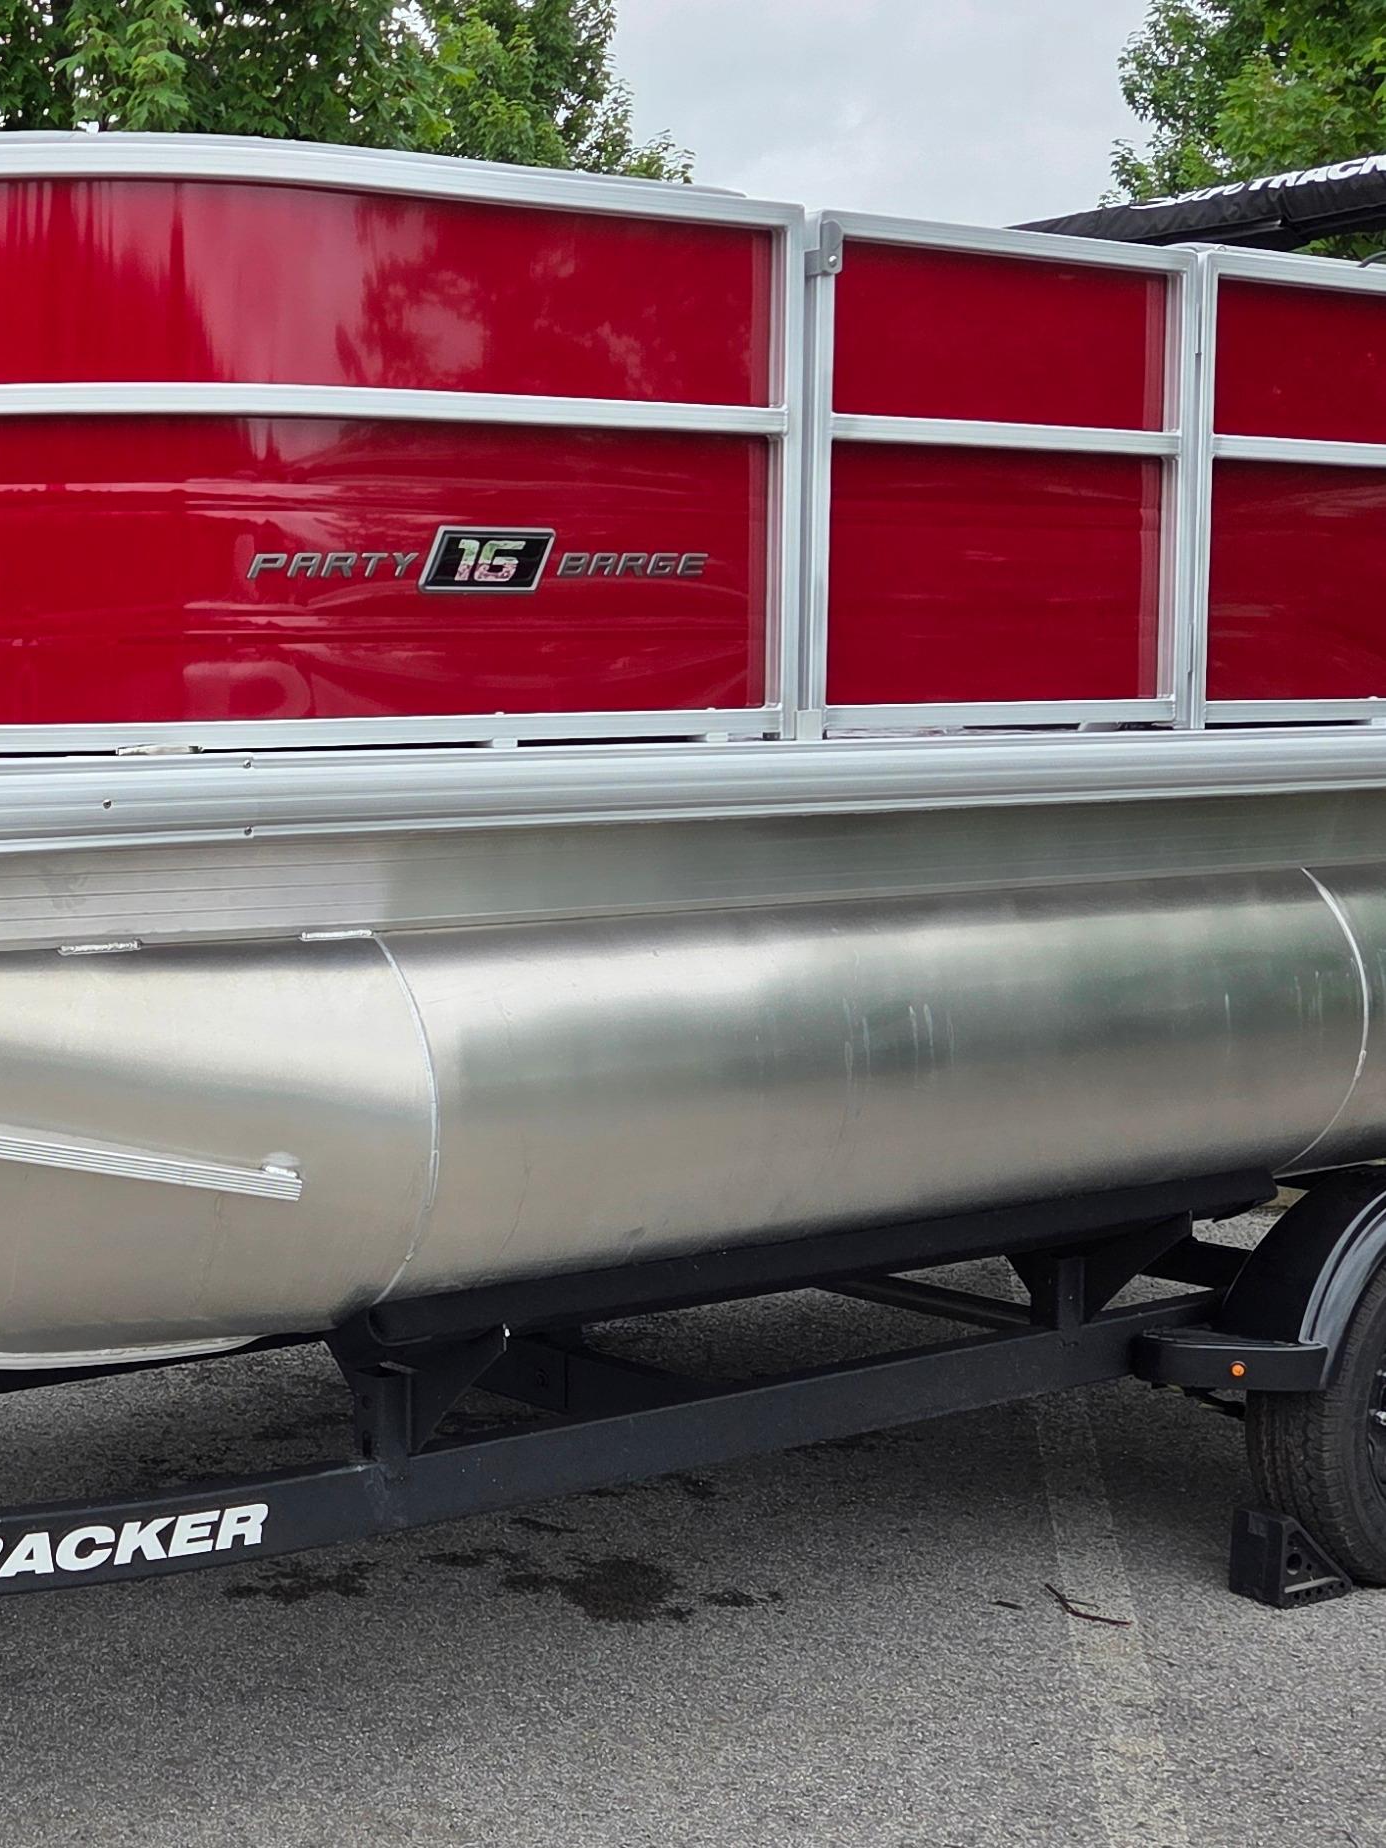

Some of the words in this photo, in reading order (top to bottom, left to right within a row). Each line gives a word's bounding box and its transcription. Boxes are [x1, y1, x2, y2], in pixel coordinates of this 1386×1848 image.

[247, 552, 419, 580] PARTY
[453, 539, 527, 582] 16
[556, 552, 709, 578] BARGE
